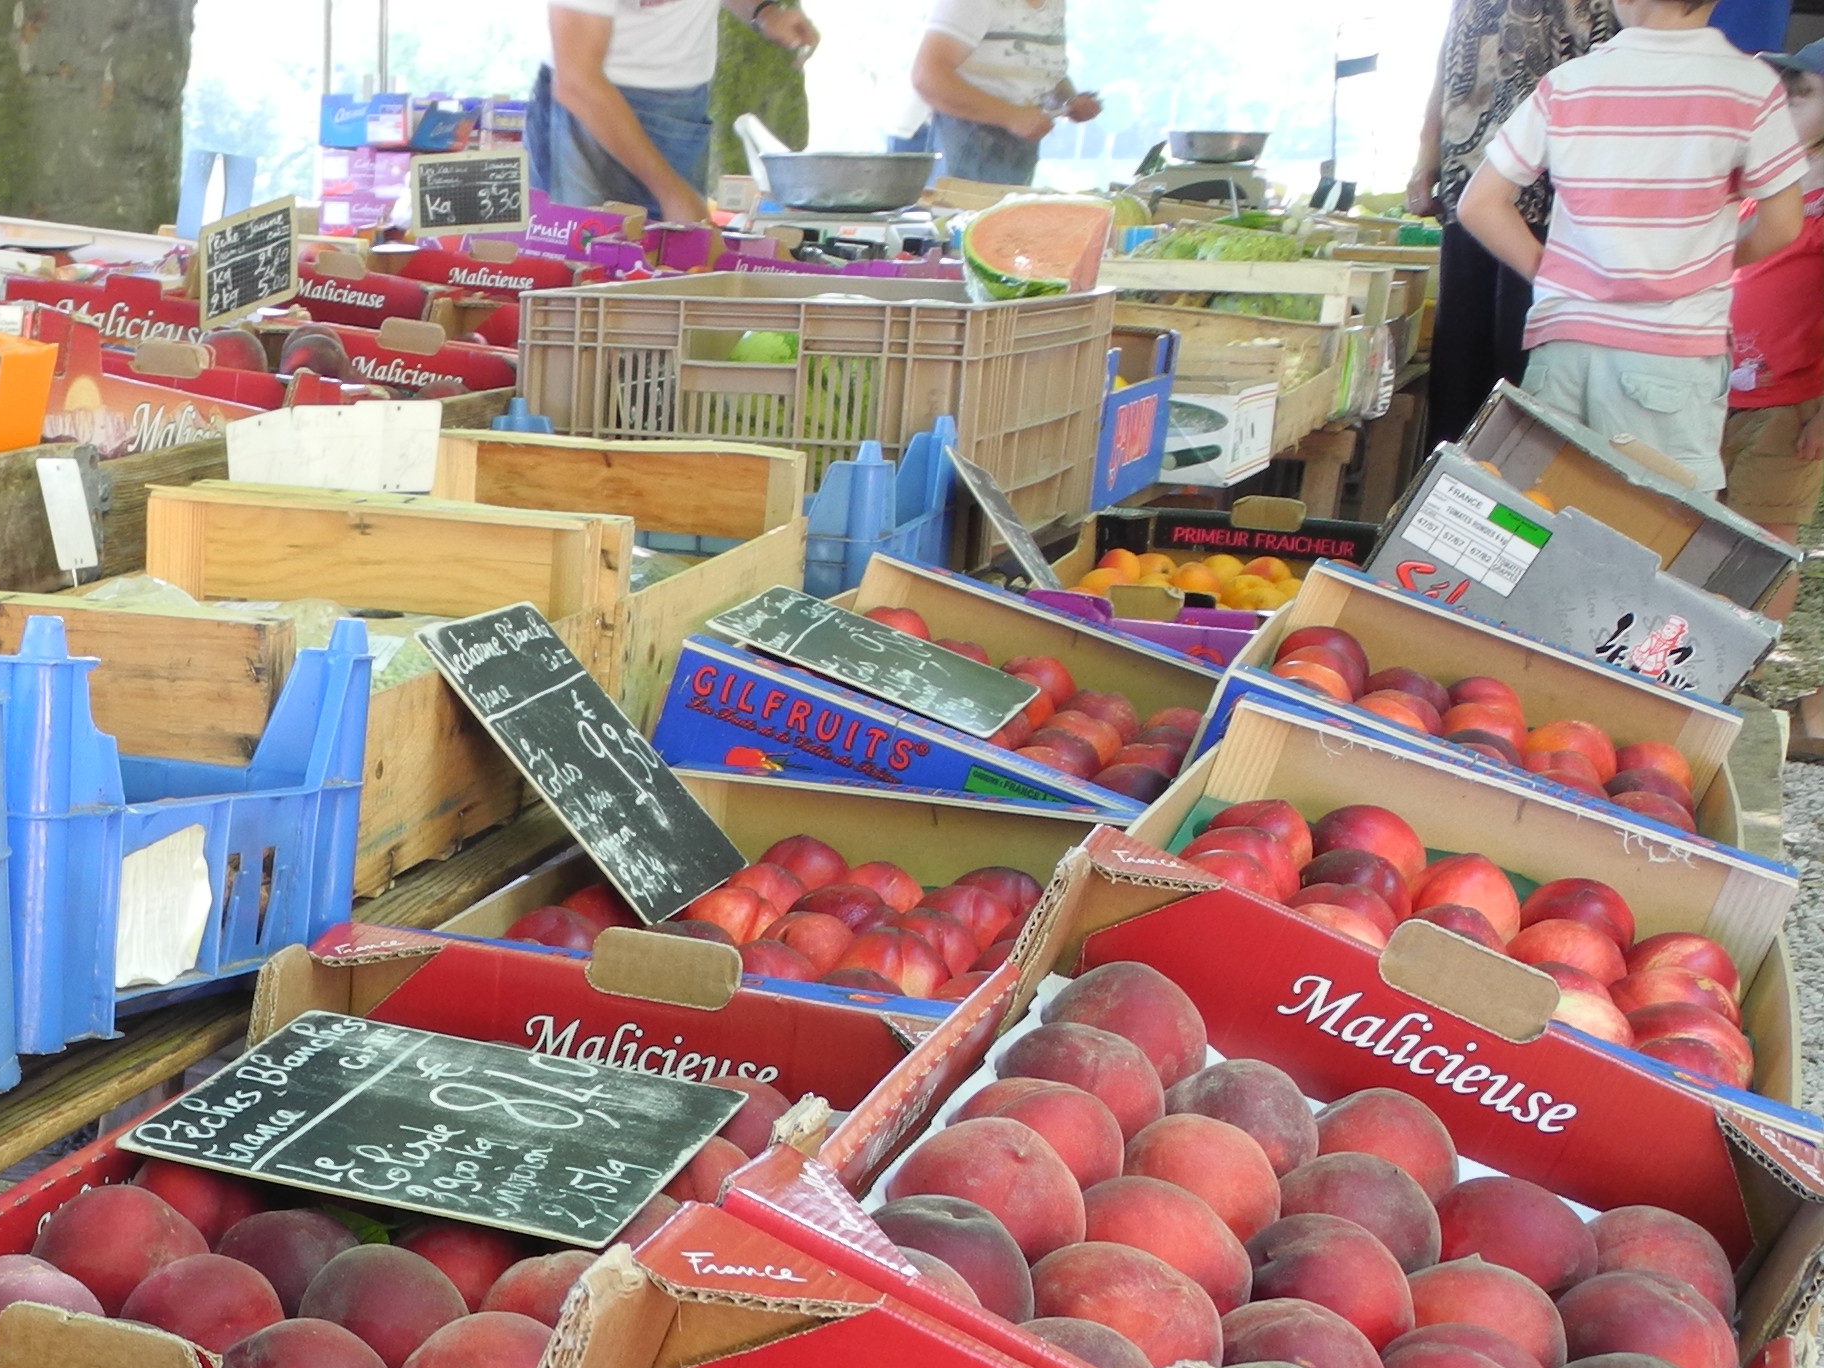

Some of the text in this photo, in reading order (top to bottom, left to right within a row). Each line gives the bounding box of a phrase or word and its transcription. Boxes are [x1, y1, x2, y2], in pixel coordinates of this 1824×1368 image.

[297, 277, 386, 309] Malicieuse
[448, 266, 534, 290] Malicieuse
[1447, 486, 1484, 510] FRANCE
[1171, 526, 1355, 557] PRIMEUR FRAICHEUR
[1111, 849, 1186, 869] France
[333, 939, 406, 955] France
[1276, 973, 1579, 1136] Malicieuse
[135, 1017, 369, 1150] Pêches Blanches
[203, 1107, 307, 1164] France
[680, 1249, 808, 1283] France
